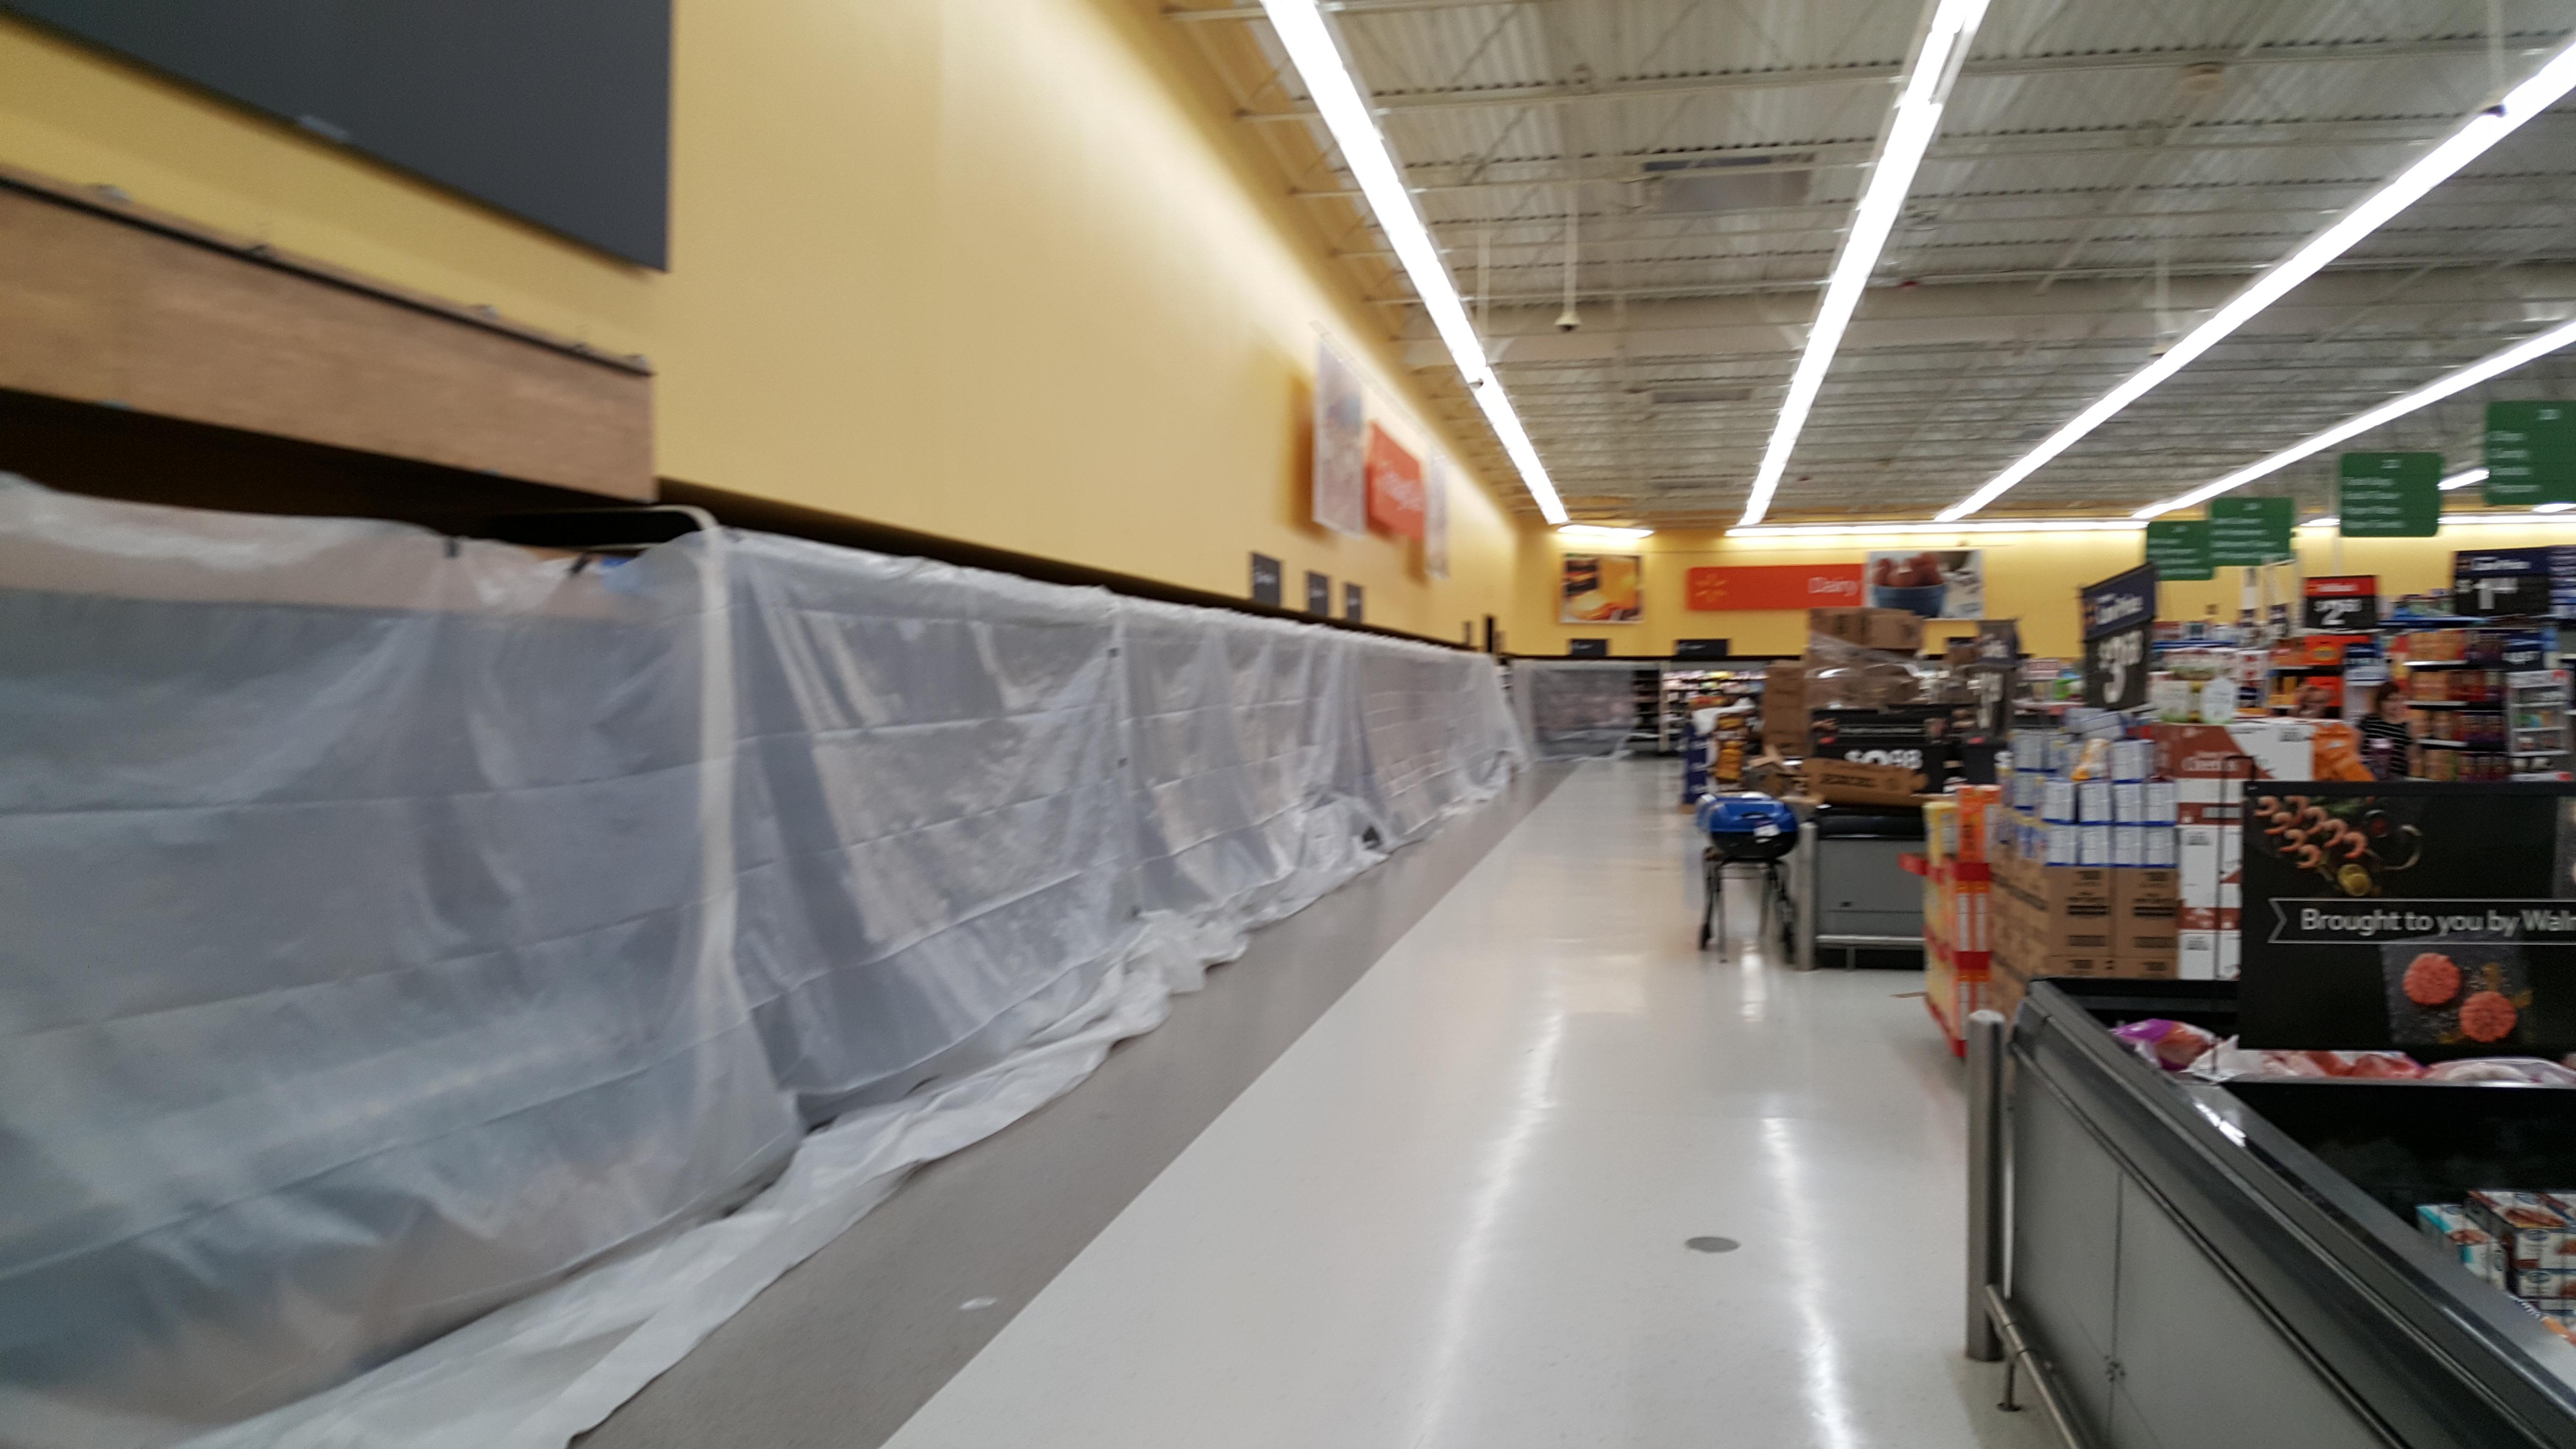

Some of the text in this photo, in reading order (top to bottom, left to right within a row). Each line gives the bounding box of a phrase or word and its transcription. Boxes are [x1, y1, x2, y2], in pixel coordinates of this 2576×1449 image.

[1808, 577, 1857, 597] Dairy
[2301, 908, 2403, 936] Brought
[2404, 911, 2434, 931] to
[2436, 916, 2485, 937] you
[2486, 909, 2521, 937] by
